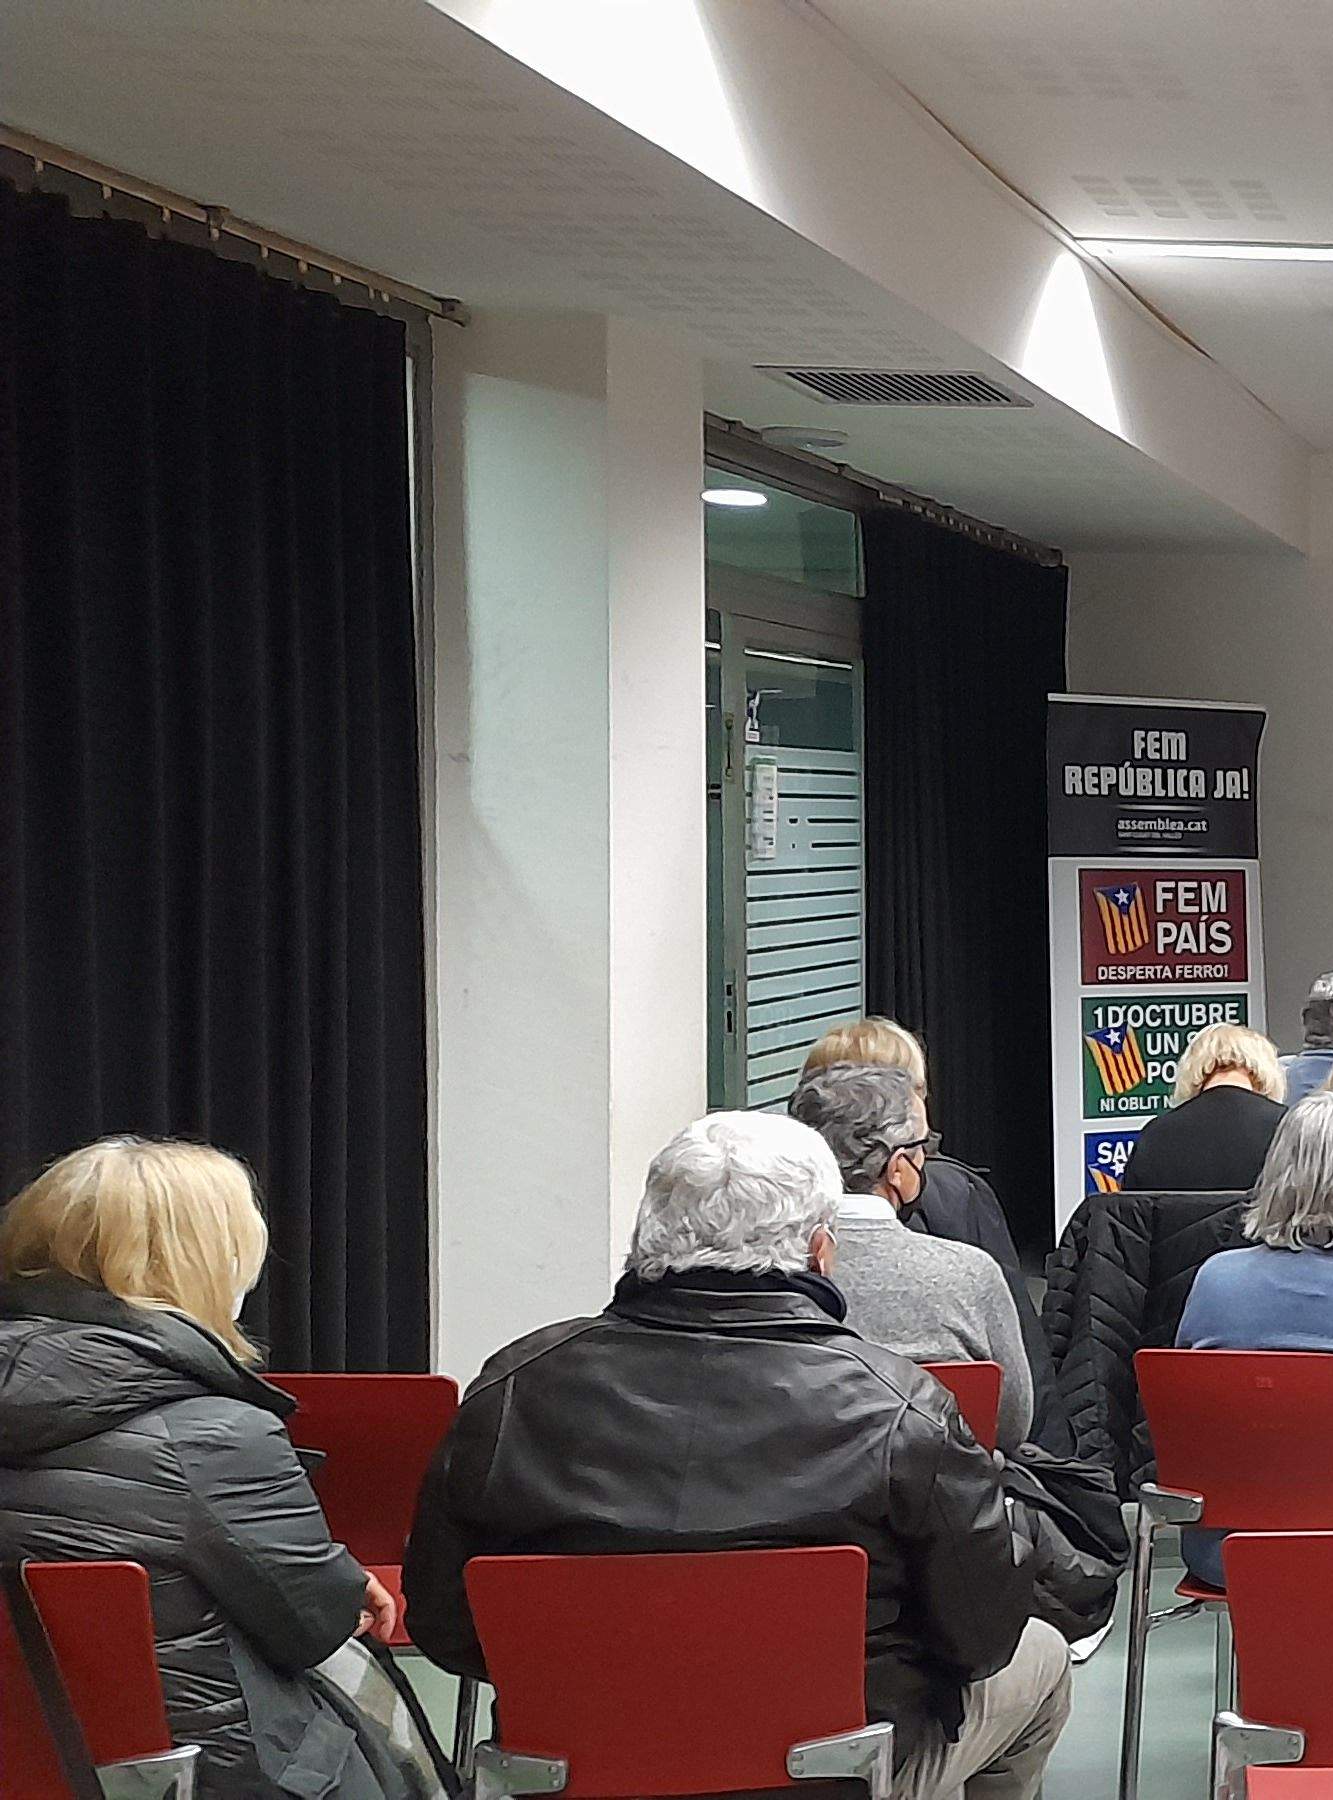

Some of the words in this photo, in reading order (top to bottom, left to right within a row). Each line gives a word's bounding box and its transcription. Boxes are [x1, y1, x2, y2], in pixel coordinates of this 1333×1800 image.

[1133, 730, 1187, 760] FEM
[1064, 761, 1206, 798] REPÚBLICA
[1213, 768, 1250, 799] JA!
[1117, 818, 1208, 832] assemblea.cat
[1155, 881, 1227, 913] FEM
[1156, 914, 1233, 955] PAÍS
[1097, 964, 1173, 980] DESPERTA
[1175, 964, 1229, 979] FERRO!
[1146, 1031, 1180, 1056] UN
[1146, 1060, 1177, 1084] PO
[1100, 1097, 1115, 1112] NI
[1117, 1095, 1160, 1111] OBLIT
